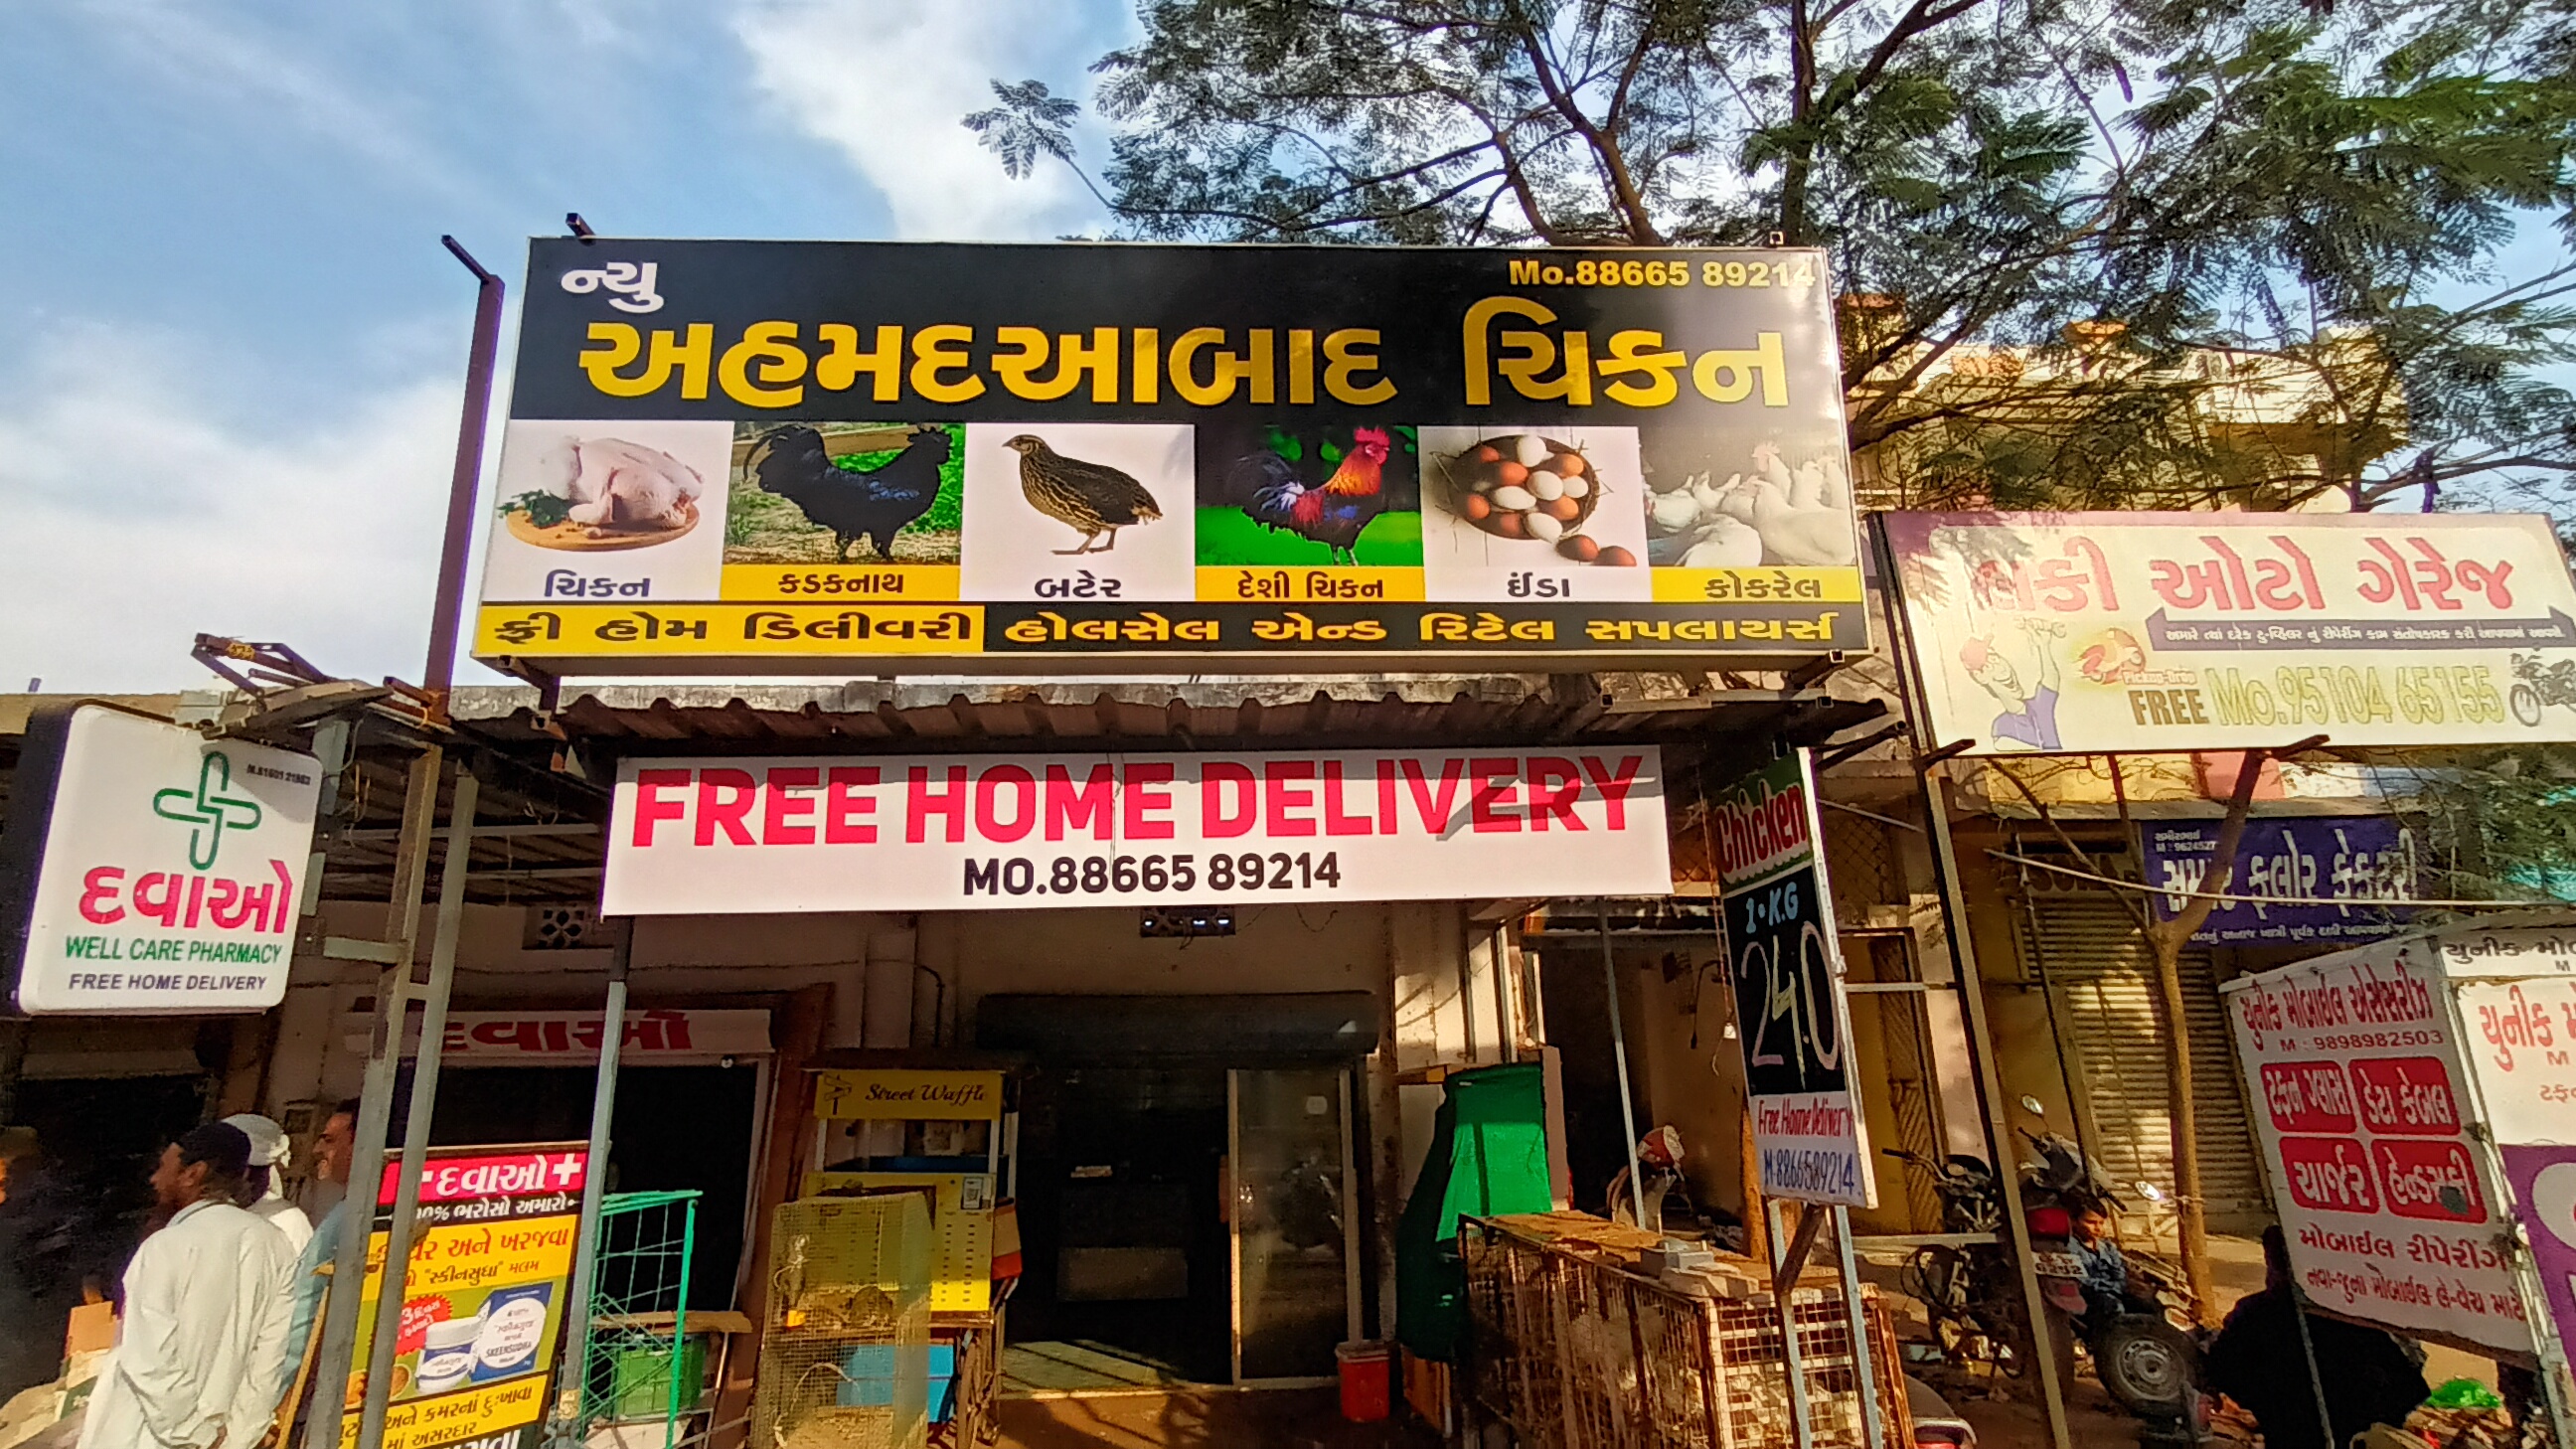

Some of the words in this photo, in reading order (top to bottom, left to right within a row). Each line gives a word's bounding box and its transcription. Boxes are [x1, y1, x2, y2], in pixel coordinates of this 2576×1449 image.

[560, 259, 665, 314] ન્યુ
[1509, 259, 1690, 288] Mo.88665
[1701, 259, 1817, 289] 89214
[576, 319, 1399, 409] અહમદઆબાદ
[1462, 295, 1791, 408] ચિકન
[543, 567, 652, 600] ચિકન
[776, 569, 905, 596] કડકનાથ
[1033, 569, 1124, 600] બટેર
[1236, 568, 1292, 600] દેશી
[1305, 568, 1385, 600] ચિકન
[1702, 569, 1824, 600] કોકરેલ
[2150, 536, 2327, 612] ઓટો
[2356, 537, 2516, 612] ગેરેજ
[594, 610, 709, 642] હોમ
[743, 610, 973, 642] ડિલીવરી
[1003, 610, 1221, 644] હોલસેલ
[1250, 610, 1388, 643] એન્ડ
[1419, 610, 1555, 643] રિટેલ
[2128, 689, 2210, 726] FREE
[2204, 663, 2392, 728] Mo.95104
[2397, 664, 2506, 727] 65155
[632, 765, 882, 848] FREE
[905, 762, 1175, 844] HOME
[1201, 755, 1644, 839] DELIVERY
[1716, 776, 1808, 875] Chicken
[963, 853, 1197, 896] MO.88665
[1207, 851, 1341, 891] 89214
[79, 858, 294, 934] દવાઓ
[66, 935, 124, 962] WELL
[129, 936, 183, 963] CARE
[187, 939, 283, 965] PHARMACY
[69, 973, 123, 992] FREE
[128, 974, 182, 992] HOME
[186, 974, 267, 993] DELIVERY
[2279, 1038, 2296, 1052] M
[2478, 984, 2555, 1072] યુનીક
[866, 1082, 915, 1103] Street
[920, 1082, 987, 1107] Waffle
[1758, 1099, 1780, 1136] Free
[435, 1154, 549, 1197] દવાઓ
[446, 1226, 493, 1258] અને
[2298, 1221, 2396, 1259] મોબાઈલ
